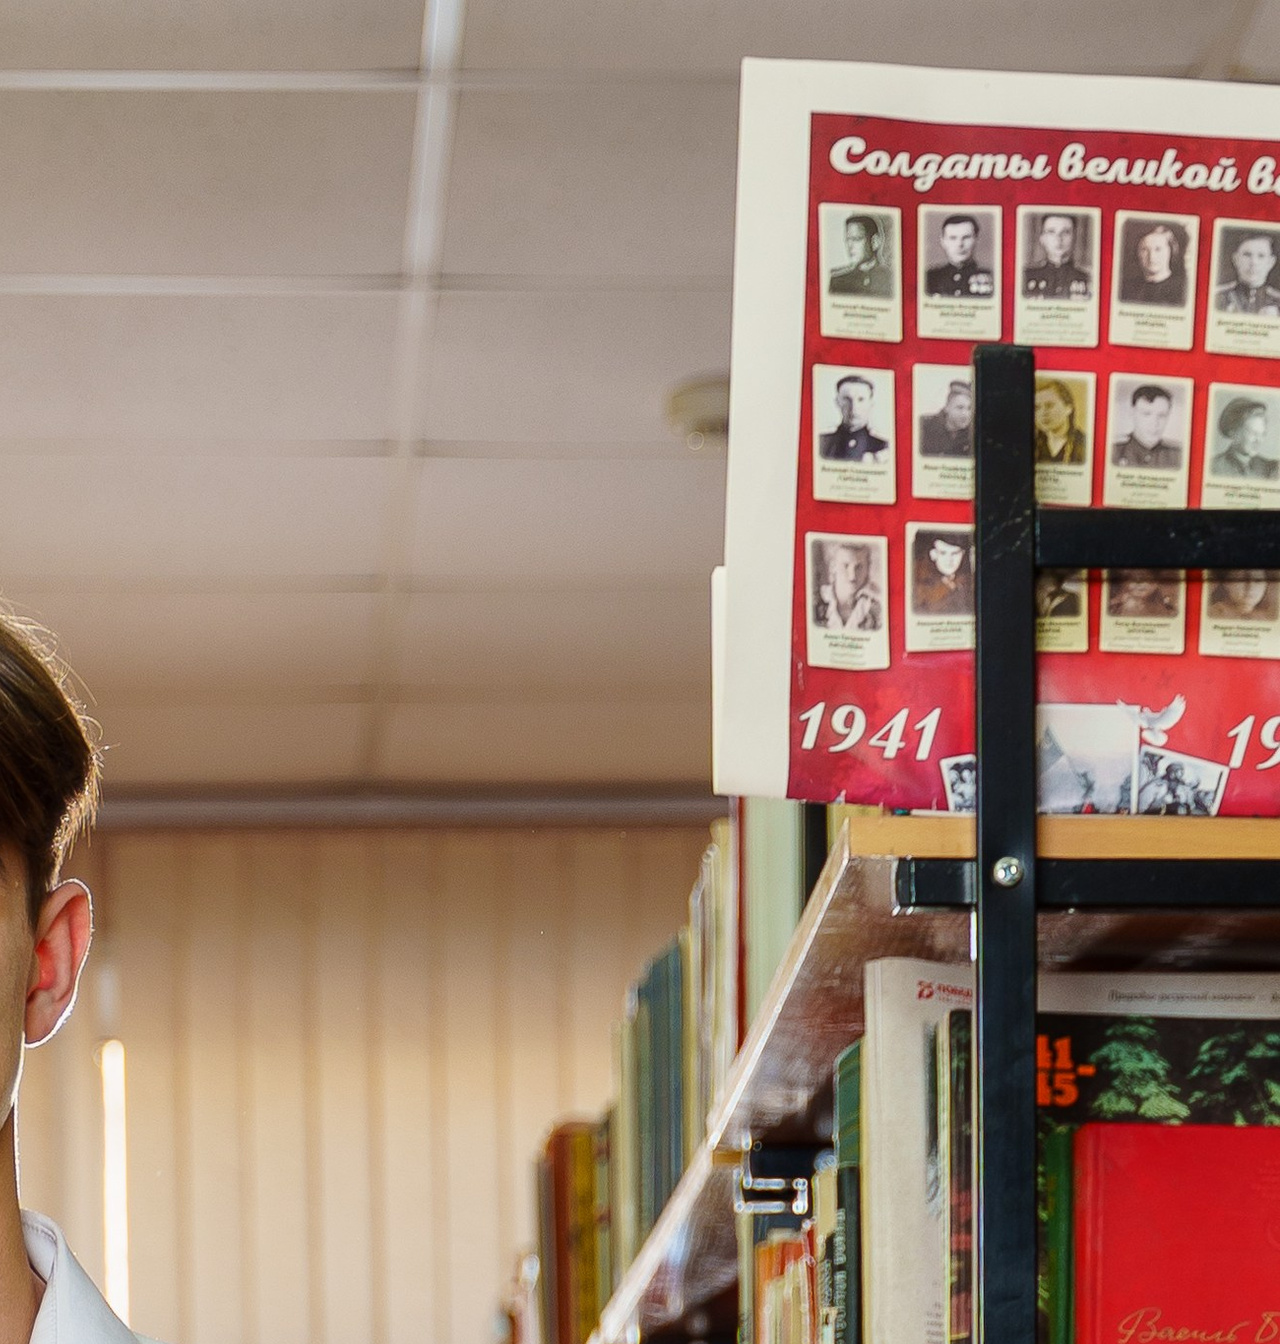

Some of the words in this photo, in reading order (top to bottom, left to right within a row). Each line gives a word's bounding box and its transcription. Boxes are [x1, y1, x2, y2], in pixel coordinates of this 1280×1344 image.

[829, 136, 1051, 192] Солдаты
[1058, 142, 1242, 192] великой
[1247, 156, 1280, 198] в
[798, 701, 942, 761] 1941
[1118, 1307, 1251, 1344] Василь
